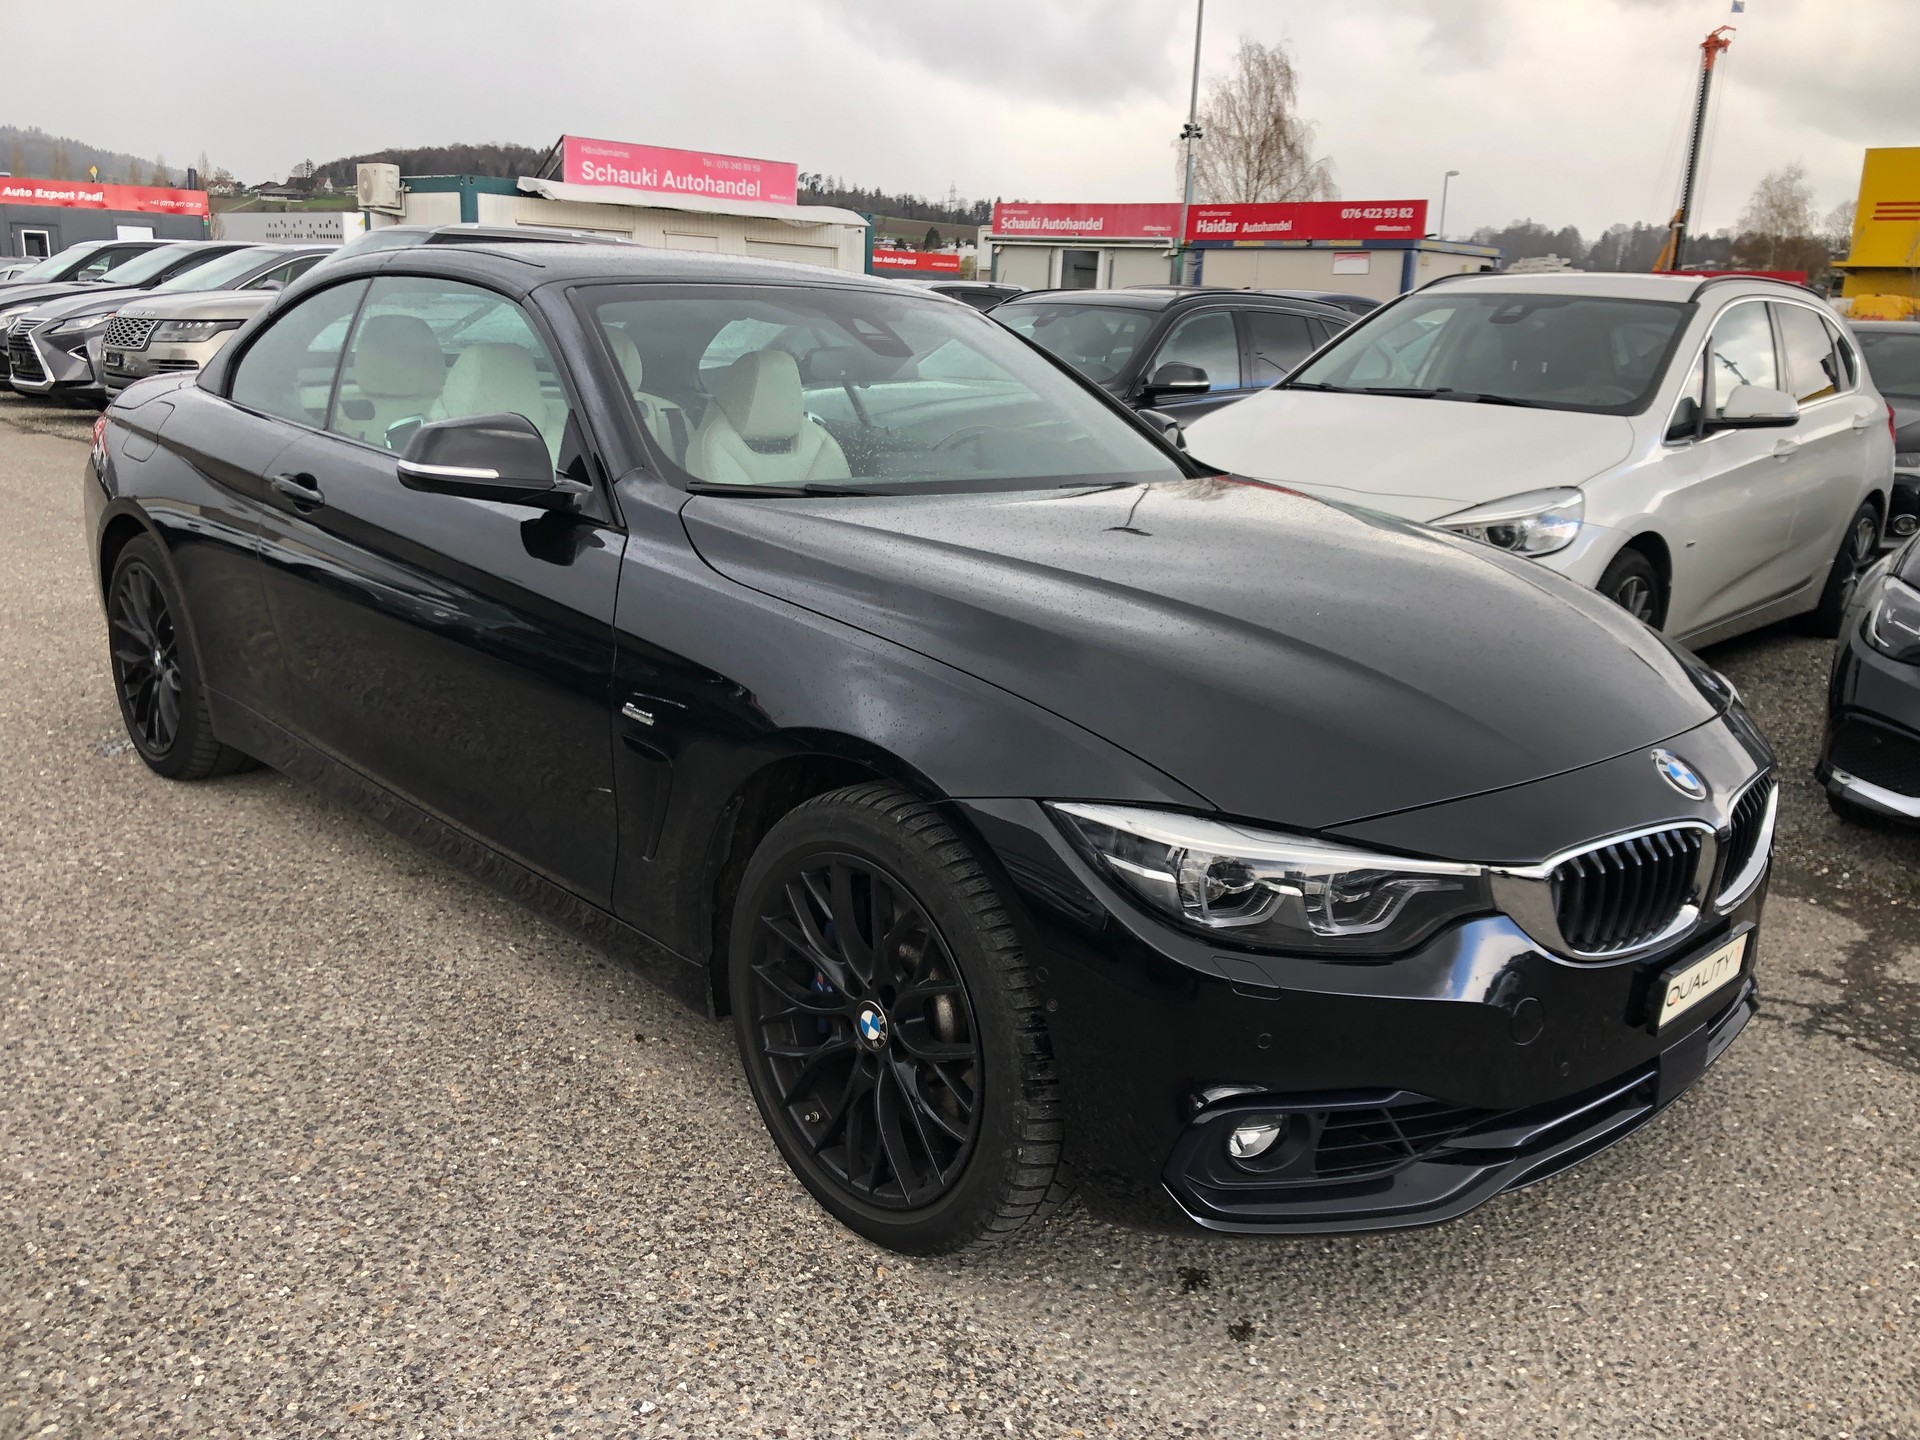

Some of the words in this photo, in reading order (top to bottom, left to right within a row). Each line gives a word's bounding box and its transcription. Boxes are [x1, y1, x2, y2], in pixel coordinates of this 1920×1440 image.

[581, 160, 658, 187] Schauki
[662, 169, 760, 197] Autohandel
[2, 187, 32, 197] Auto
[35, 189, 75, 200] Export
[78, 192, 103, 201] Fadi
[1341, 208, 1361, 219] 076
[1362, 208, 1383, 218] 422
[1383, 208, 1398, 218] 93
[1399, 207, 1414, 218] 82
[1001, 217, 1041, 229] Schauki
[1041, 217, 1104, 230] Autohandel
[1196, 219, 1239, 233] Haidar
[1241, 220, 1292, 233] Autohandel
